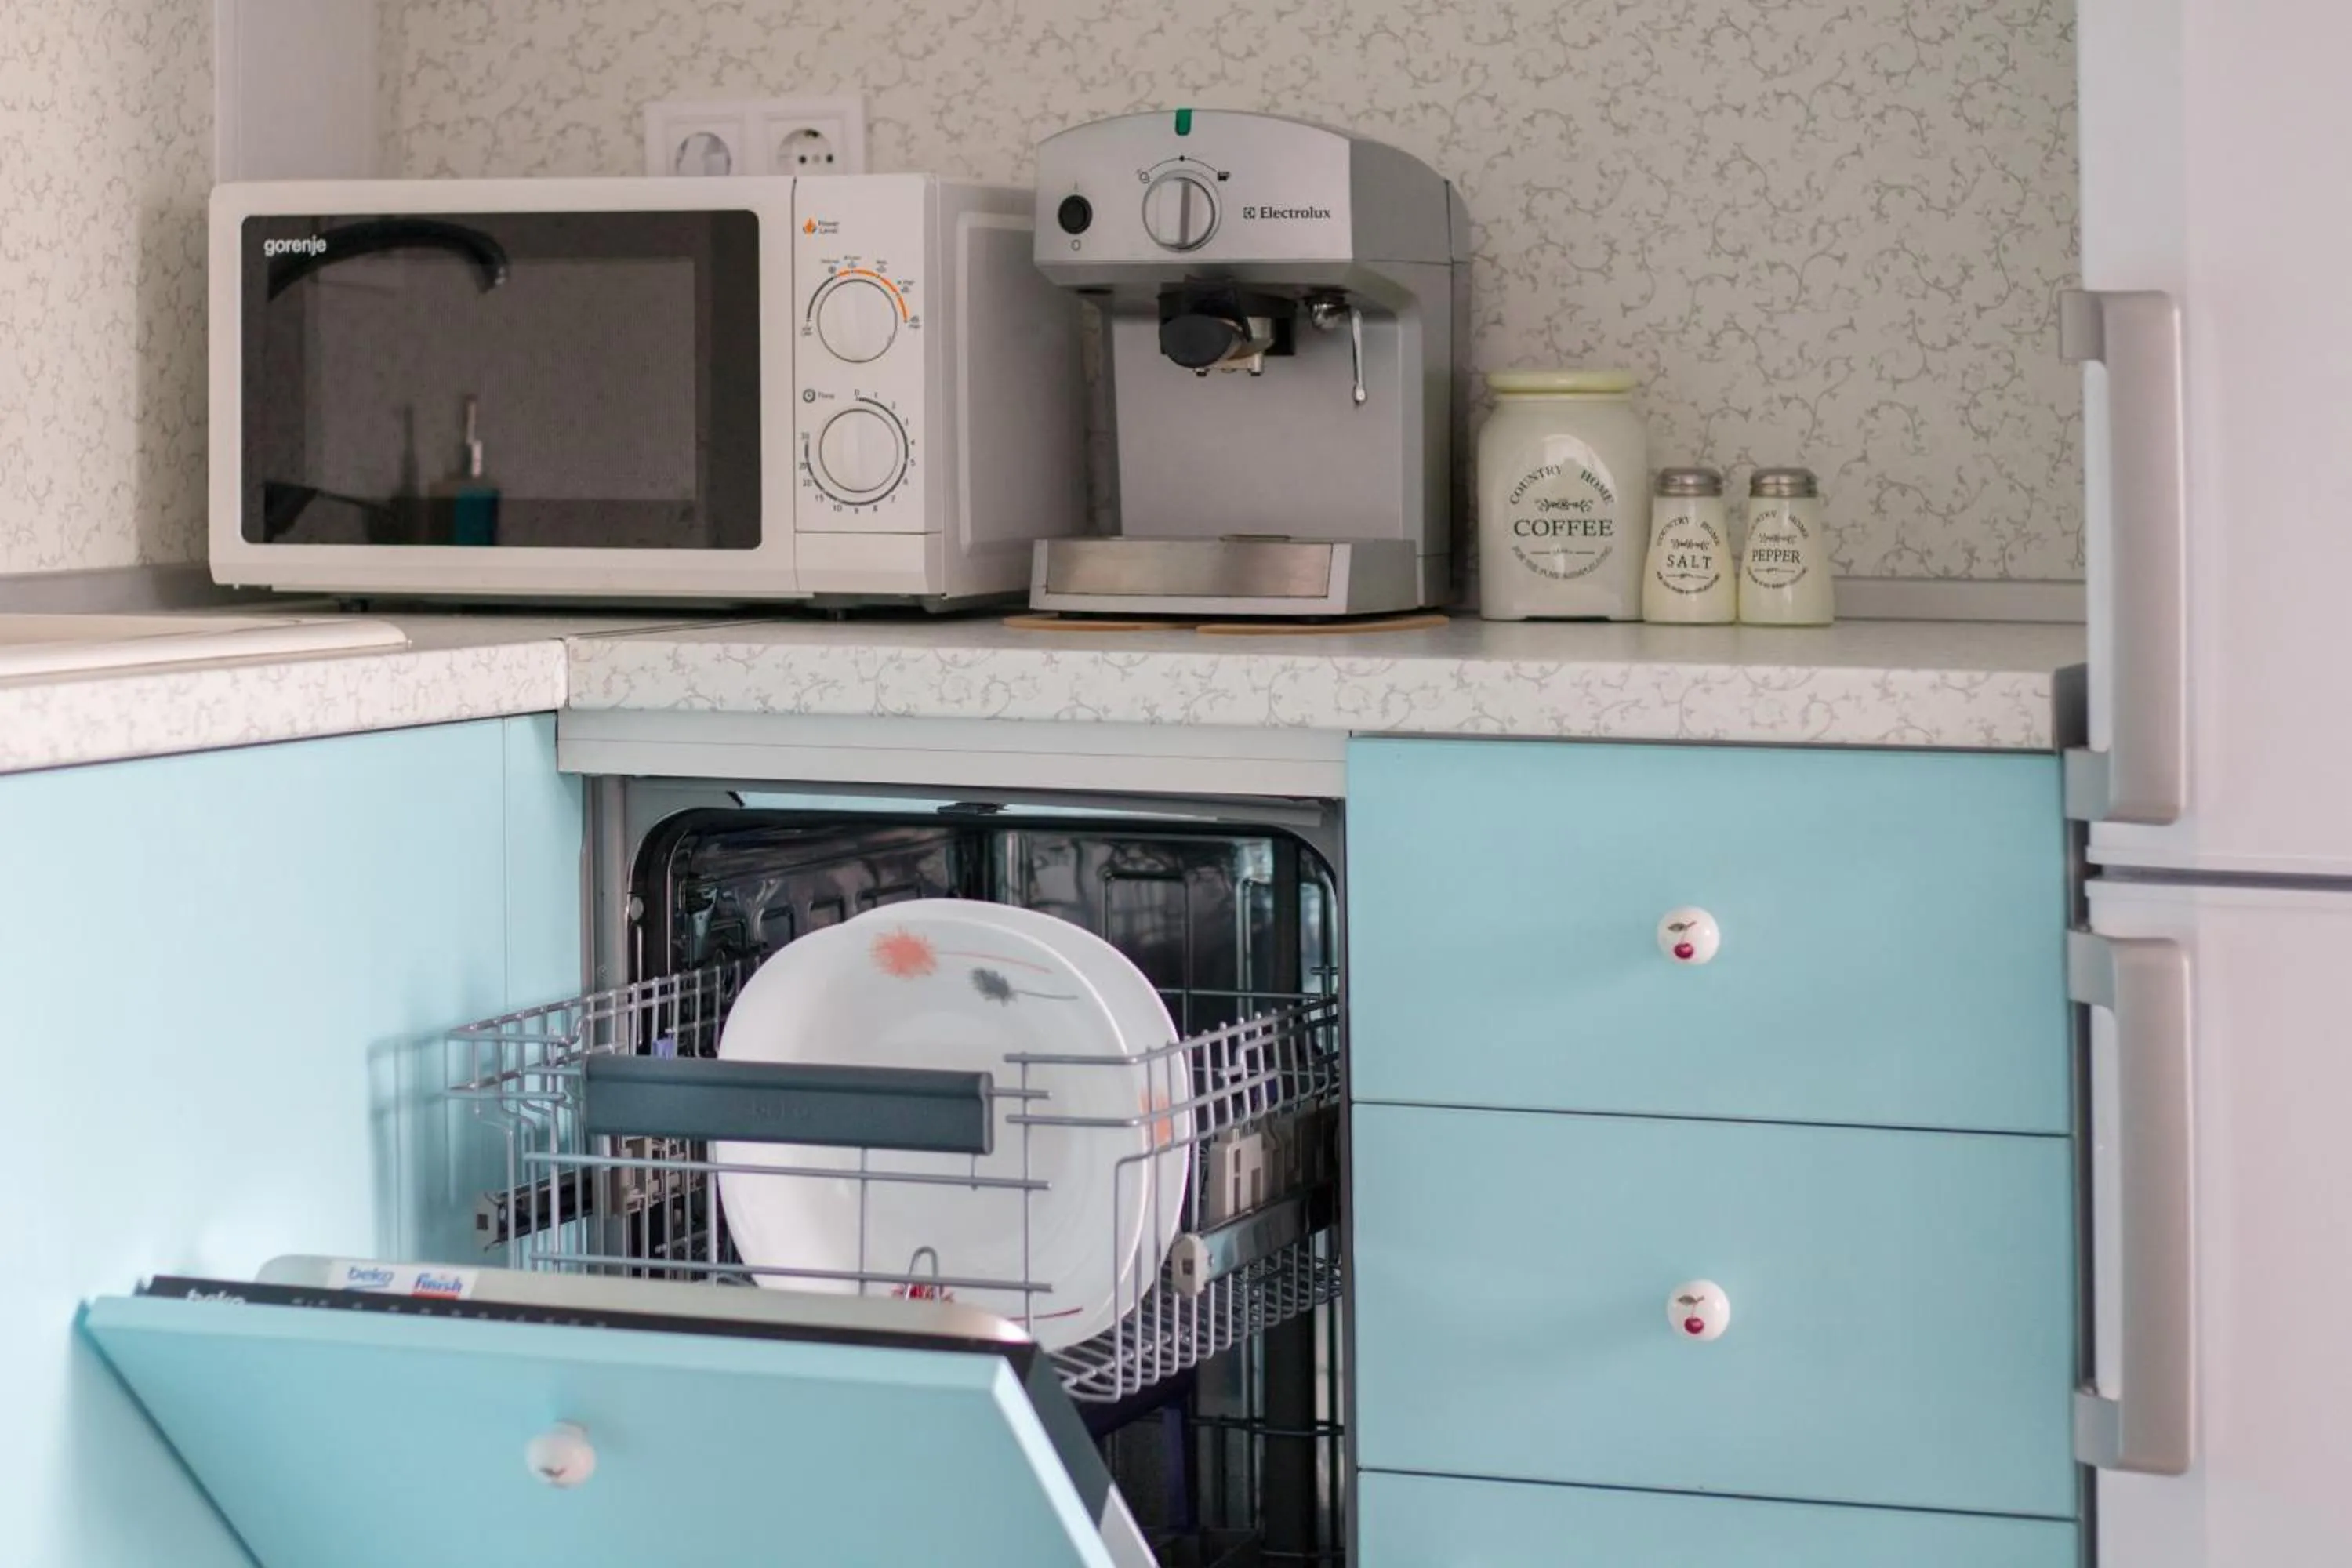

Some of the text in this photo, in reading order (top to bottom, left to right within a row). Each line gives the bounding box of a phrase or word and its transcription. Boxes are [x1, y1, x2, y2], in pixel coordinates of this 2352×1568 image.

[1260, 206, 1330, 219] Electrolux
[263, 234, 327, 257] gorenje
[1509, 464, 1615, 506] COUNTRY HOME
[1513, 519, 1615, 537] COFFEE
[1666, 554, 1713, 568] SALT
[1751, 549, 1801, 564] PEPPER
[348, 1266, 463, 1292] beko finish
